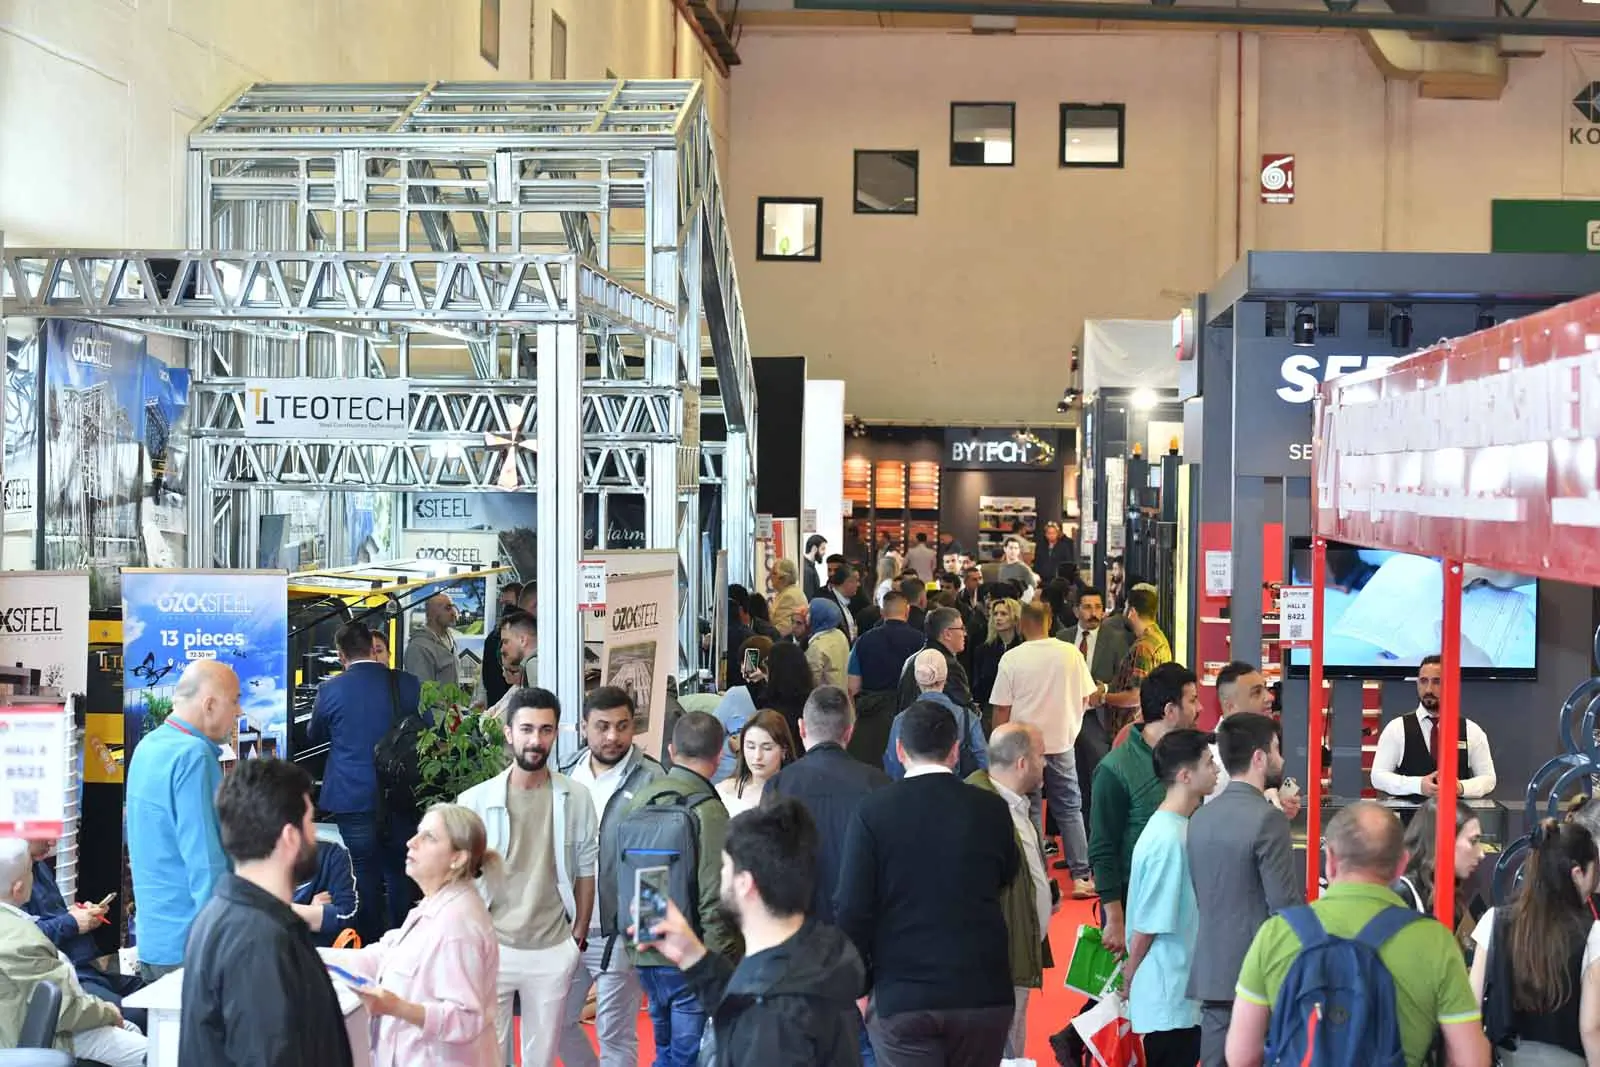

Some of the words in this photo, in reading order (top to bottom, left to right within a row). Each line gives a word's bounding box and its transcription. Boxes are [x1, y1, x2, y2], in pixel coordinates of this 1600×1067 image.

[275, 395, 405, 421] TEOTECH
[160, 629, 180, 647] 13
[183, 627, 246, 650] pieces
